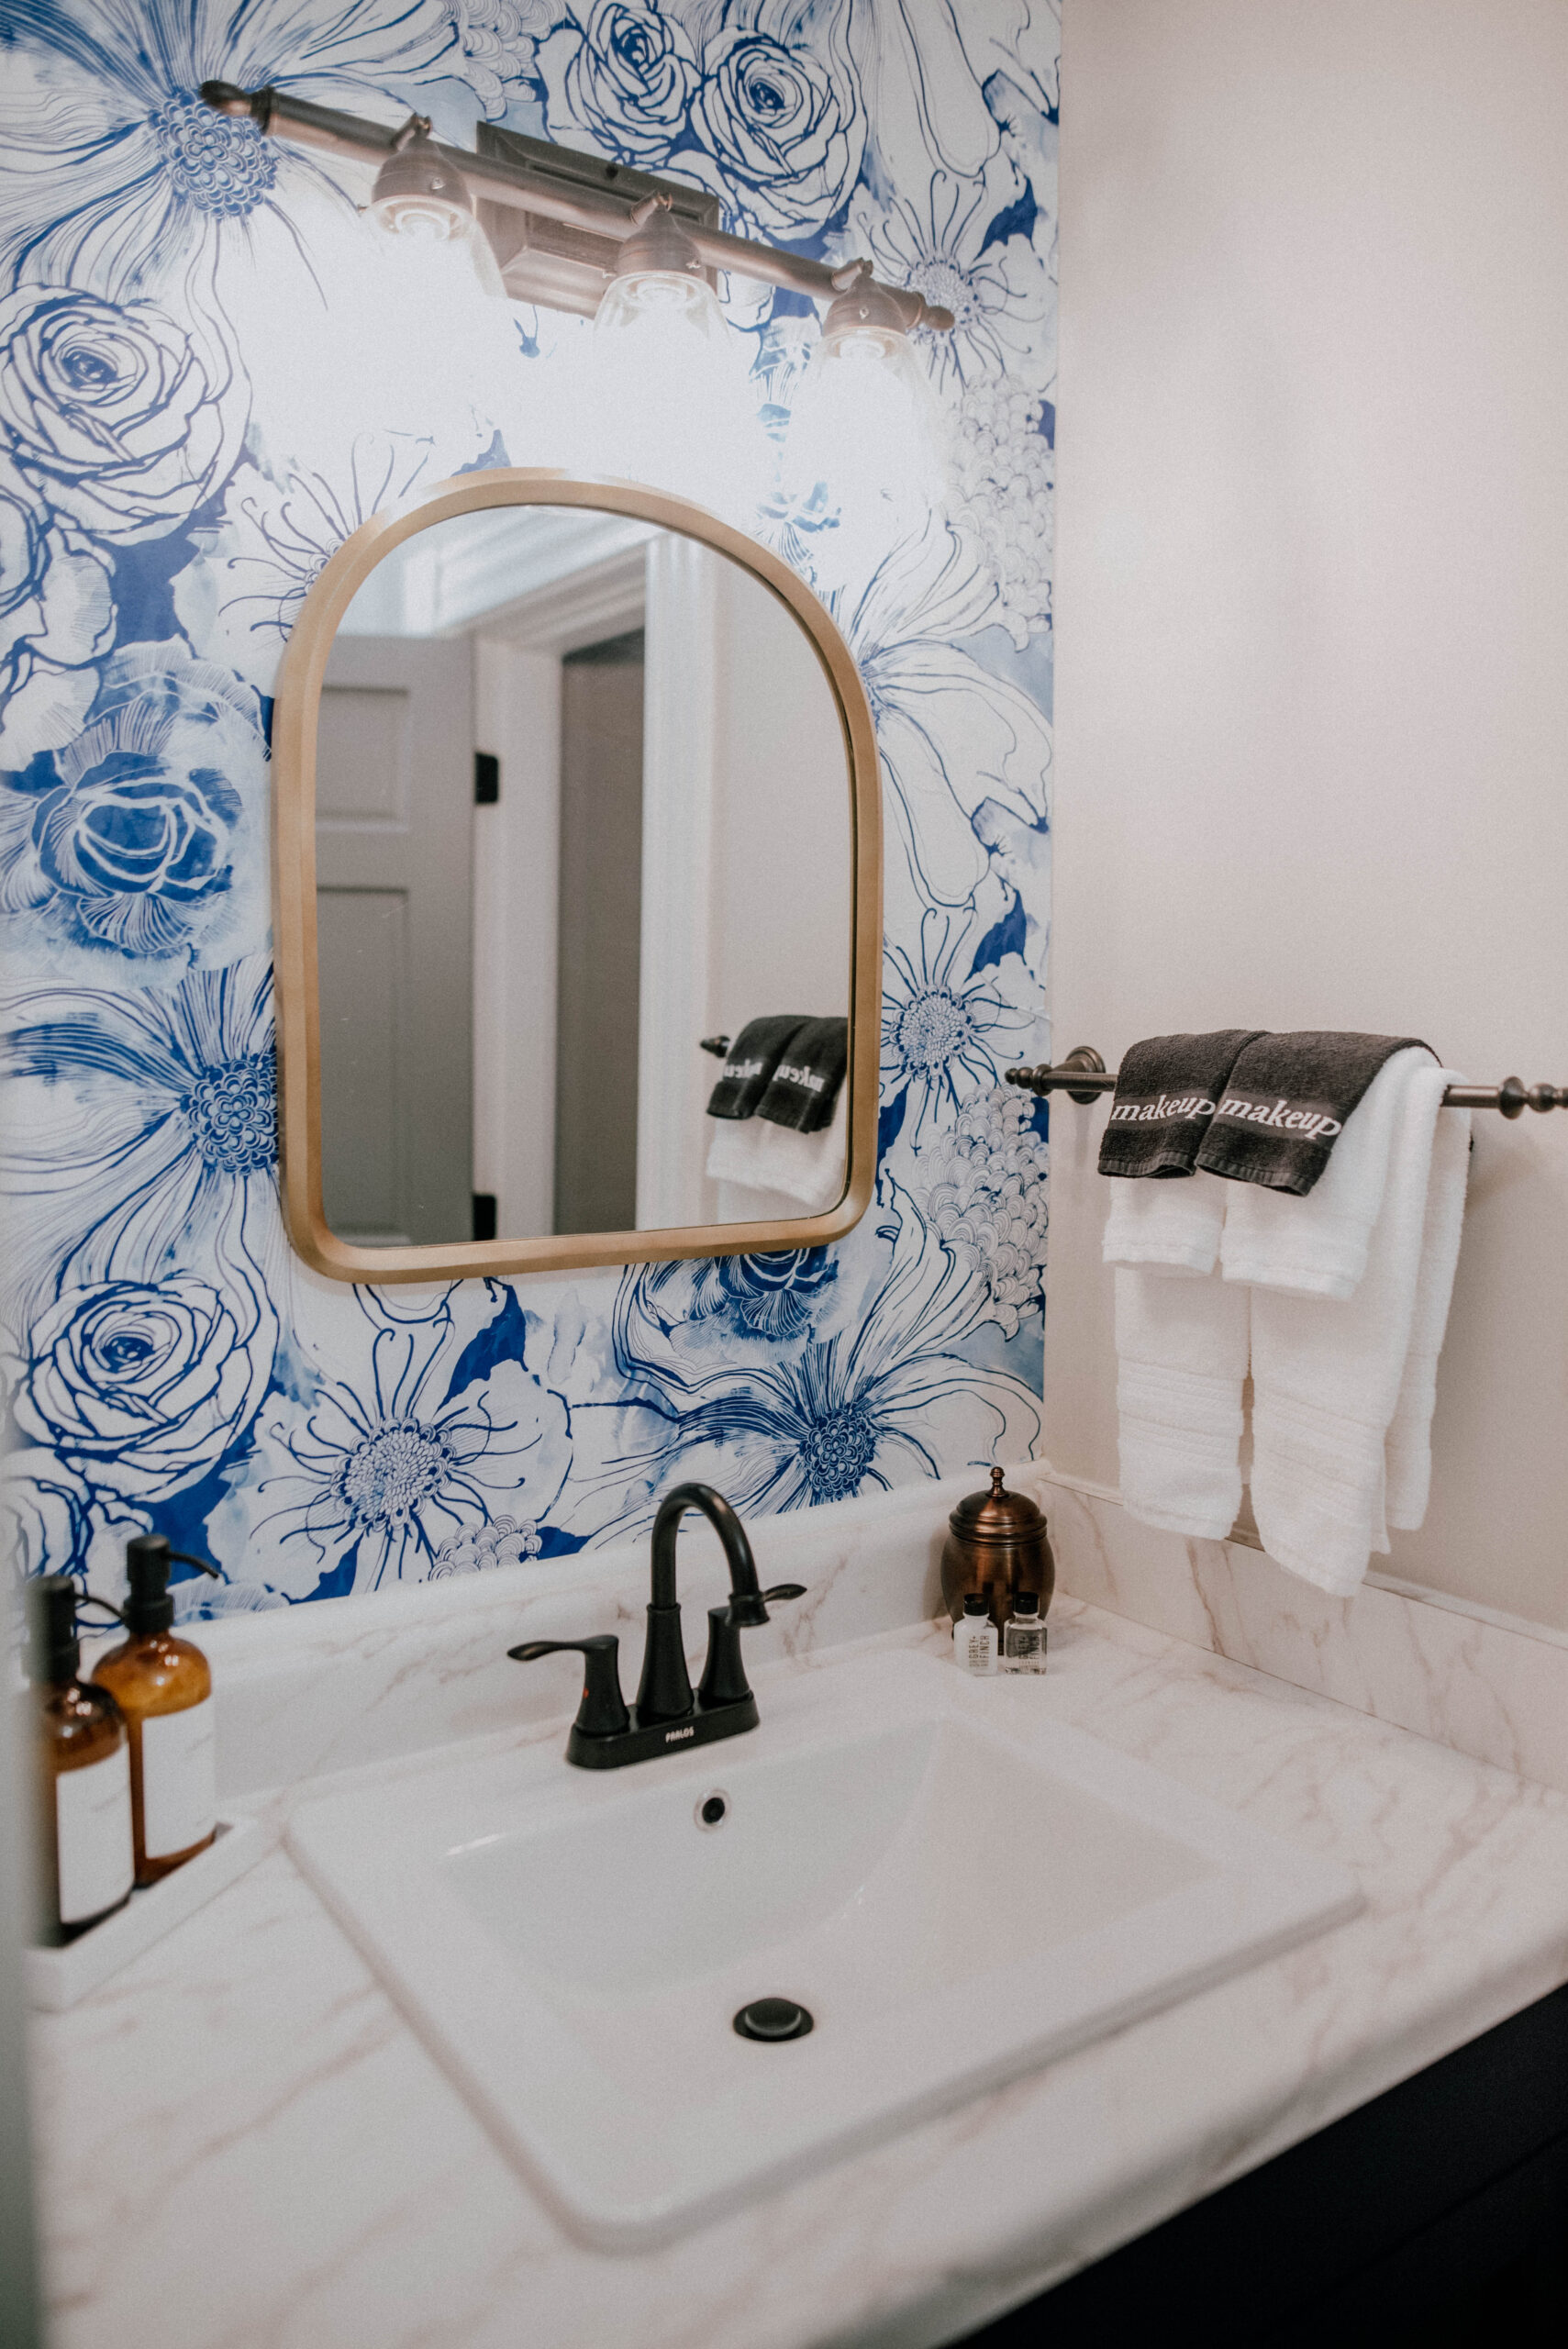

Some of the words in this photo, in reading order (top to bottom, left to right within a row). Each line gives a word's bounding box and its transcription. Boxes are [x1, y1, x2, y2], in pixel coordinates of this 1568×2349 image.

[1111, 1095, 1216, 1121] makeup
[1218, 1098, 1341, 1140] makeup
[979, 1635, 990, 1659] FINCH
